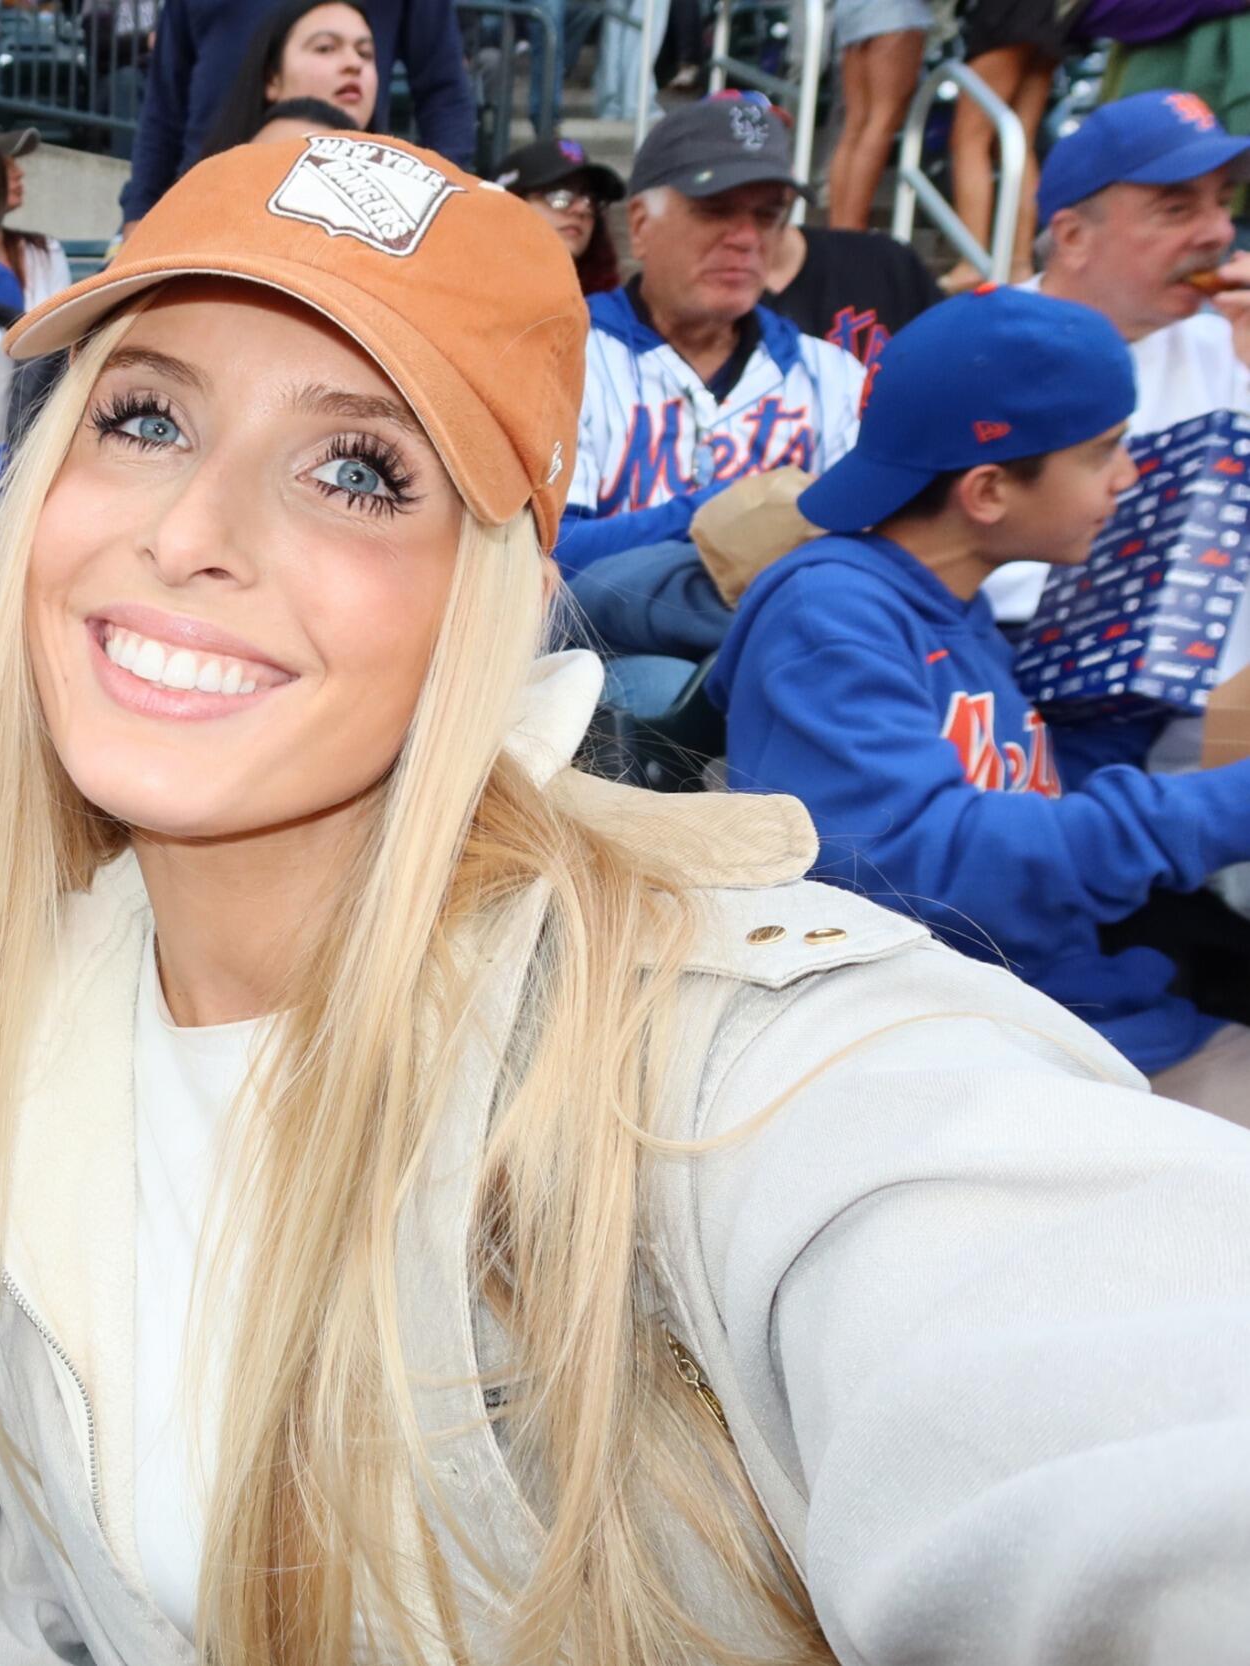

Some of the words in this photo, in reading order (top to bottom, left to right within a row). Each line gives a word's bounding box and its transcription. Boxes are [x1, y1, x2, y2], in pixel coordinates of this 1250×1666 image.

[315, 138, 380, 162] NEW
[381, 150, 447, 190] YORK
[315, 160, 410, 240] RANGERS
[597, 397, 815, 519] Mets
